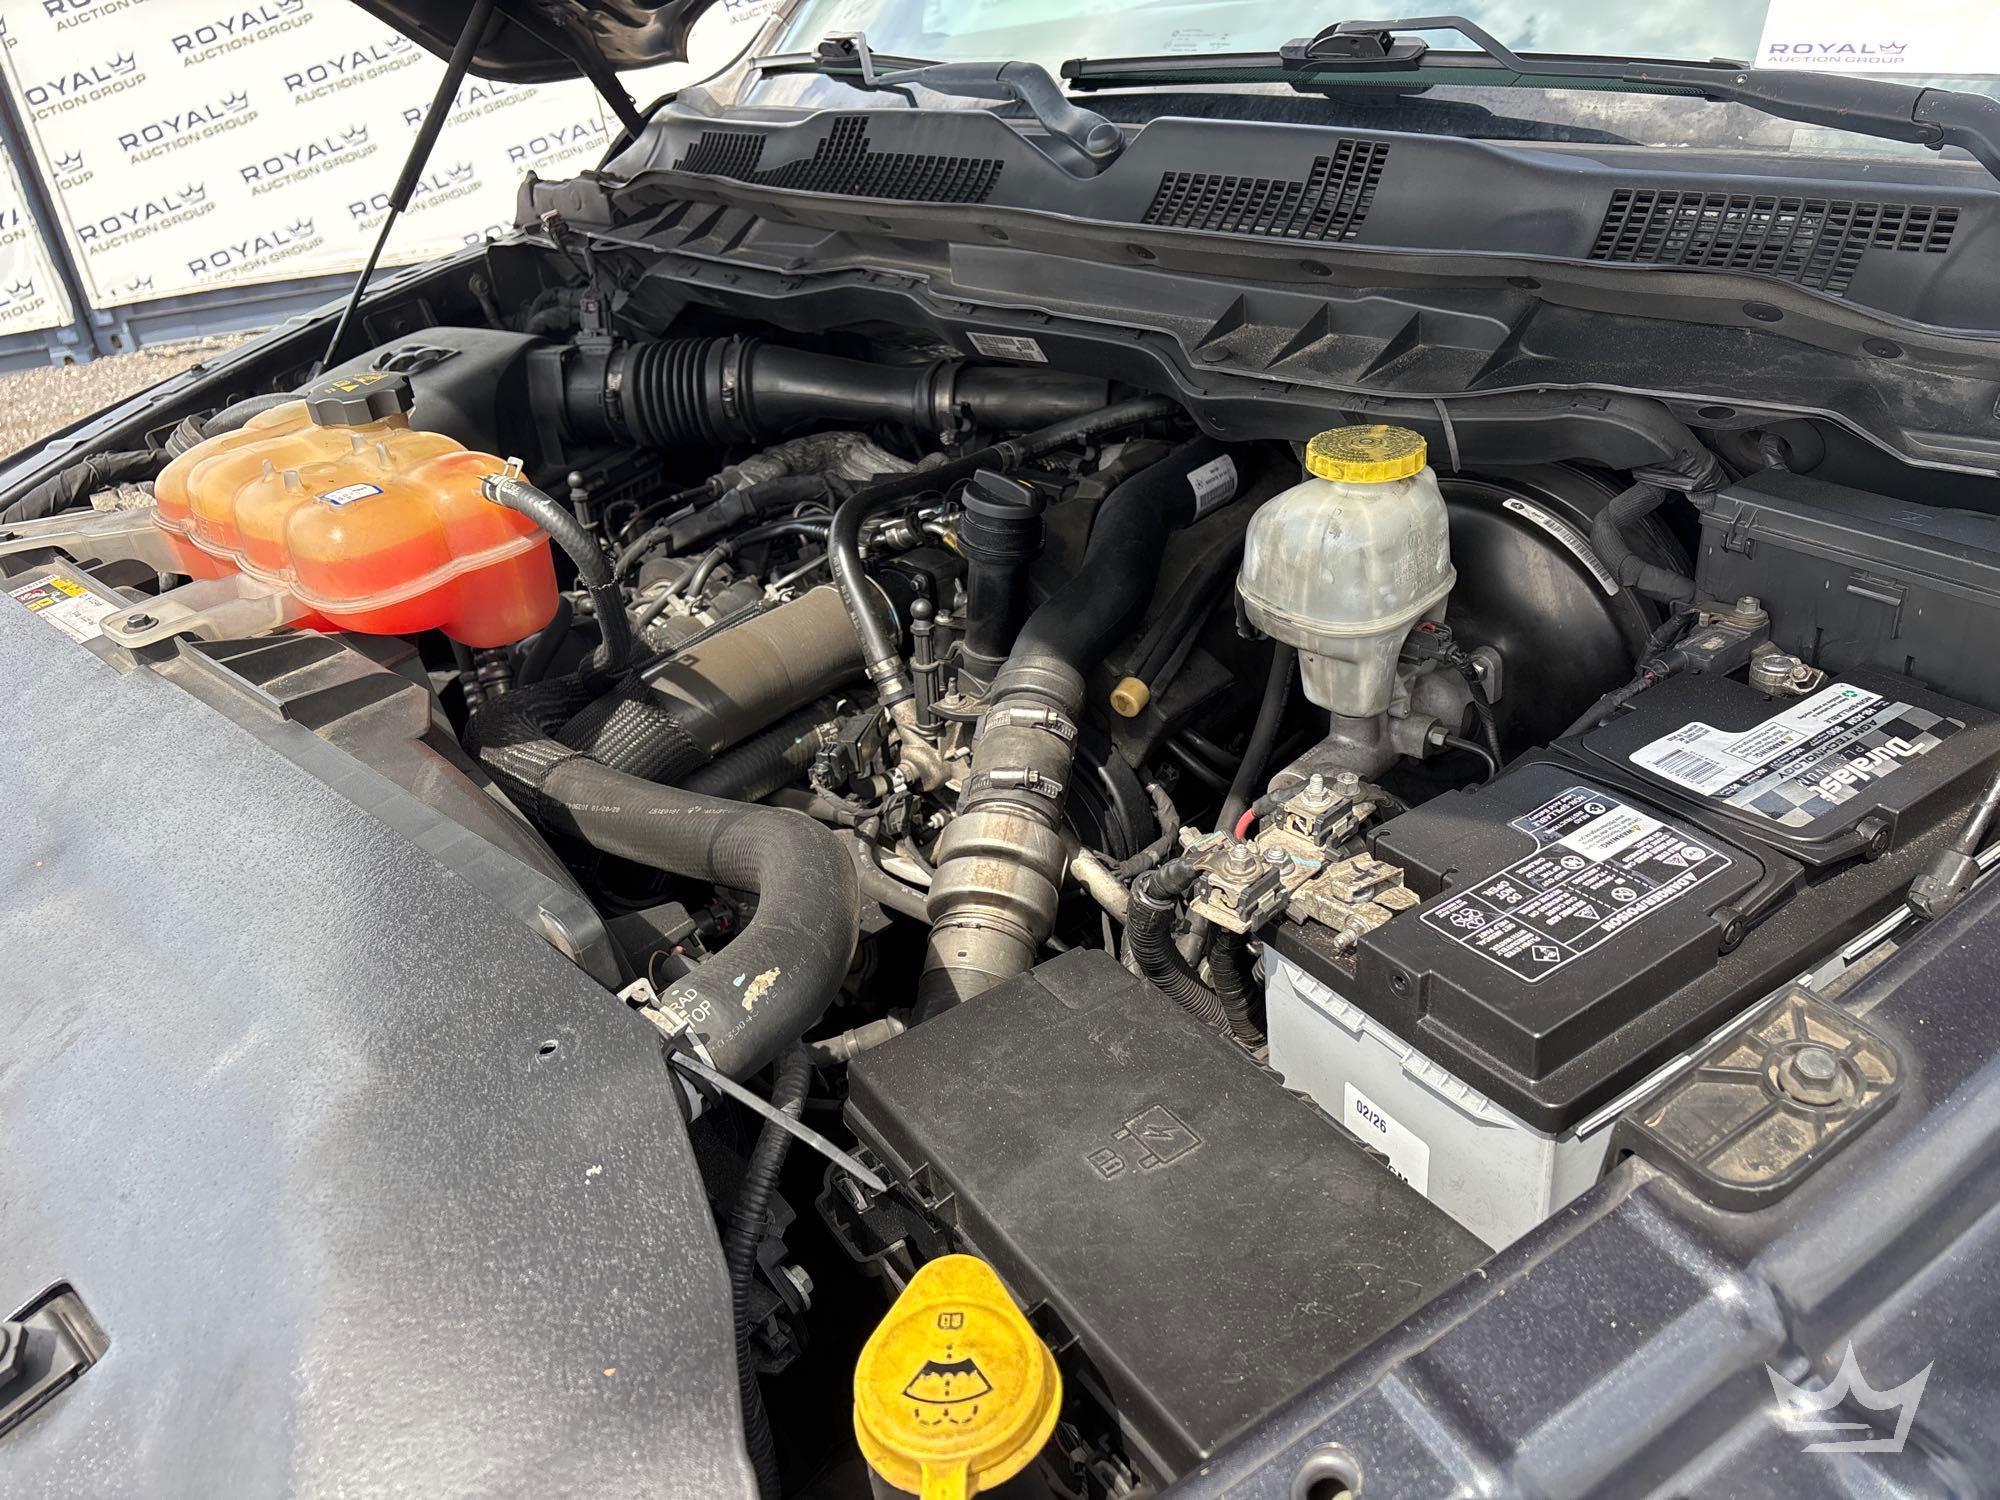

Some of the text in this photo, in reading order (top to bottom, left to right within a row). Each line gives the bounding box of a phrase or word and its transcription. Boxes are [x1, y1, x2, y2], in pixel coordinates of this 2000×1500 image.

[171, 6, 280, 54] ROYAL
[184, 12, 313, 68] AUCTION GROUP
[1769, 43, 1875, 54] ROYAL
[284, 45, 389, 92] ROYAL
[295, 52, 423, 105] AUCTION GROUP
[1768, 56, 1904, 64] AUCTION GROUP
[25, 66, 112, 105] OYAL
[32, 73, 147, 123] CTION GROUP
[403, 80, 505, 126] RYAL
[118, 104, 224, 151] ROYAL
[131, 110, 258, 165] AUCTION GROUP
[507, 119, 607, 163] ROYAL
[59, 170, 94, 190] OUP
[240, 137, 344, 183] ROYAL
[252, 143, 378, 196] AUCTION GROUP
[348, 174, 450, 219] ROAL
[78, 196, 182, 243] ROYAL
[90, 201, 216, 256] AUCTION GROUP
[188, 231, 290, 276] ROYAL
[0, 298, 45, 322] ROUP
[1849, 718, 1878, 735] AGM
[1778, 734, 1848, 779] TECHNOLOGY
[1791, 745, 1866, 787] PLATINUM
[1807, 737, 1926, 802] Duralast
[1530, 794, 1587, 827] NON-SPILLABLE
[1493, 886, 1516, 899] NOT
[1504, 892, 1523, 903] DO
[1599, 877, 1691, 931] DANGER/POISON
[670, 987, 698, 1014] RAD
[683, 999, 711, 1028] TOP
[1355, 1098, 1388, 1134] 02/26
